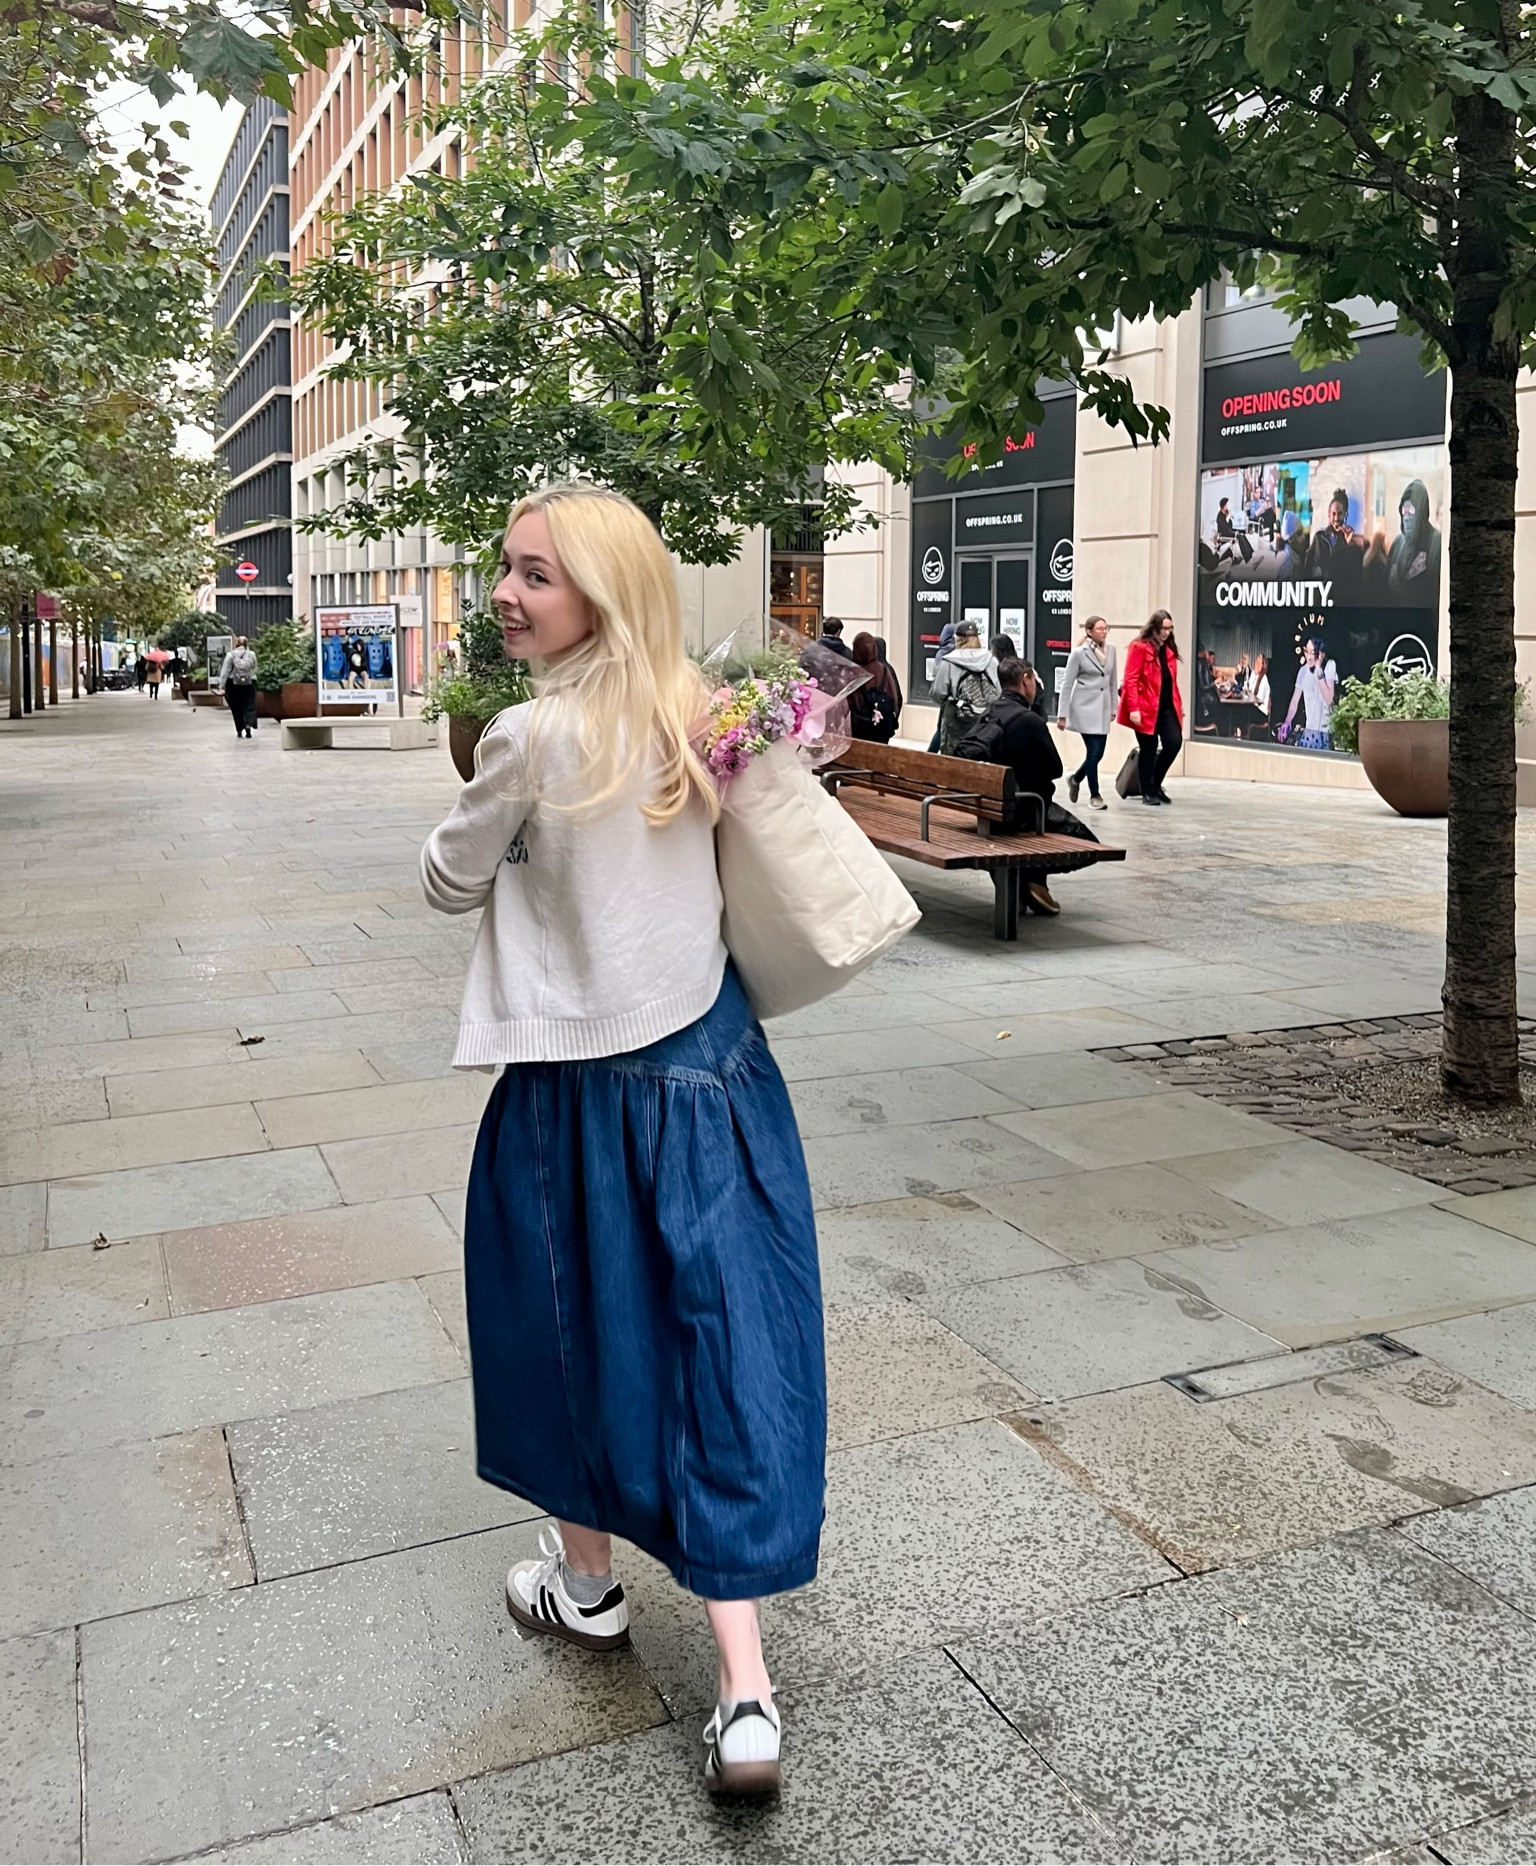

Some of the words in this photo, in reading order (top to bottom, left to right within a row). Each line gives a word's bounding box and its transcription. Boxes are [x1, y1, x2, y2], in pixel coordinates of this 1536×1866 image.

[1222, 388, 1291, 418] OPENING
[1292, 379, 1341, 407] SOON
[1221, 418, 1287, 436] OFFSPRING.CO.UK
[1005, 432, 1034, 452] SN
[965, 513, 1023, 528] OFFSPRING.CO.UK
[916, 591, 949, 602] OFFSPRING
[1042, 590, 1072, 602] OFFSPR
[1215, 581, 1334, 607] COMMUNITY.
[1006, 617, 1018, 625] NOW
[1003, 627, 1021, 635] HIRING
